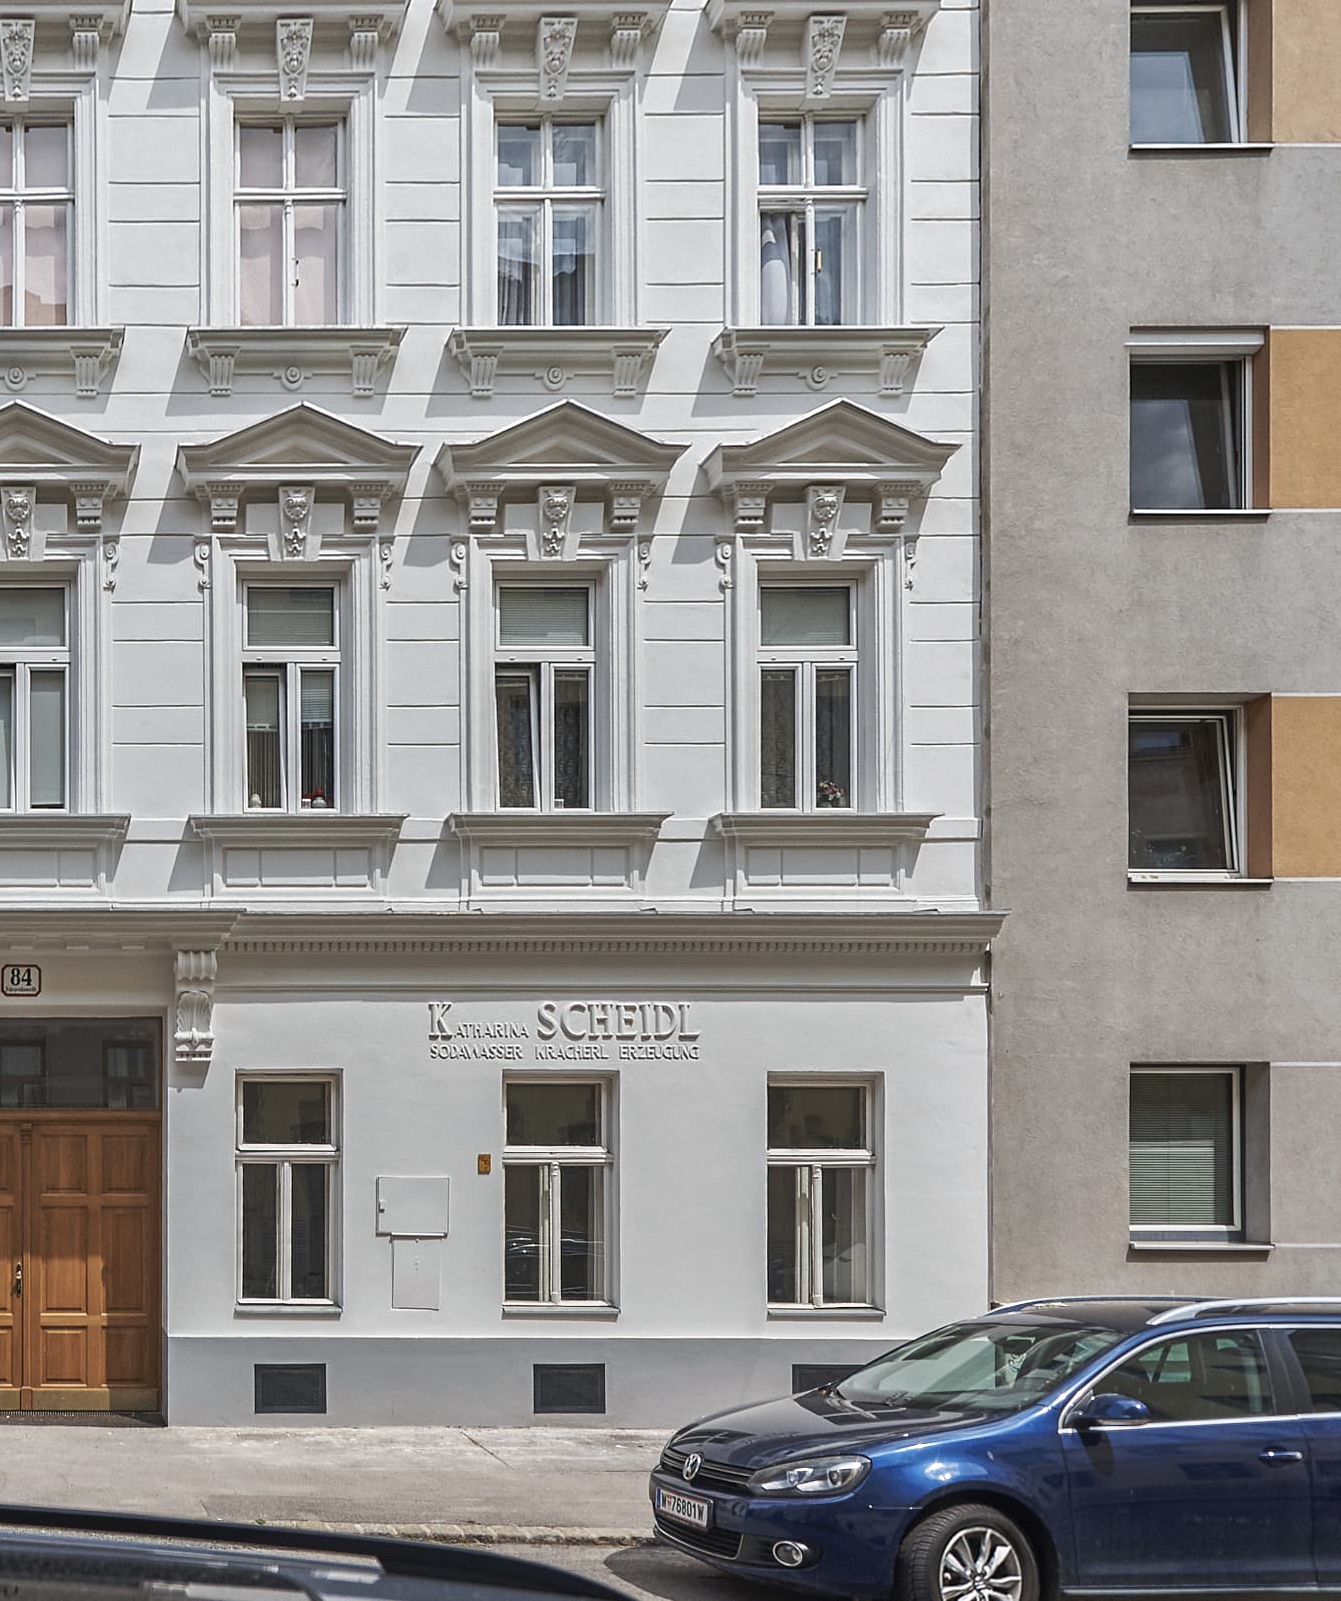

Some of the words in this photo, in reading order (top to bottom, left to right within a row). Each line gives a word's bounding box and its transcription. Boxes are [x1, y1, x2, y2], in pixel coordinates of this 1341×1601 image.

[10, 967, 32, 986] 84
[537, 1001, 701, 1042] SCHEIDL
[429, 1043, 523, 1061] SODAWASSER
[534, 1043, 610, 1061] KRACHERL
[618, 1043, 700, 1061] ERZEUGUNG
